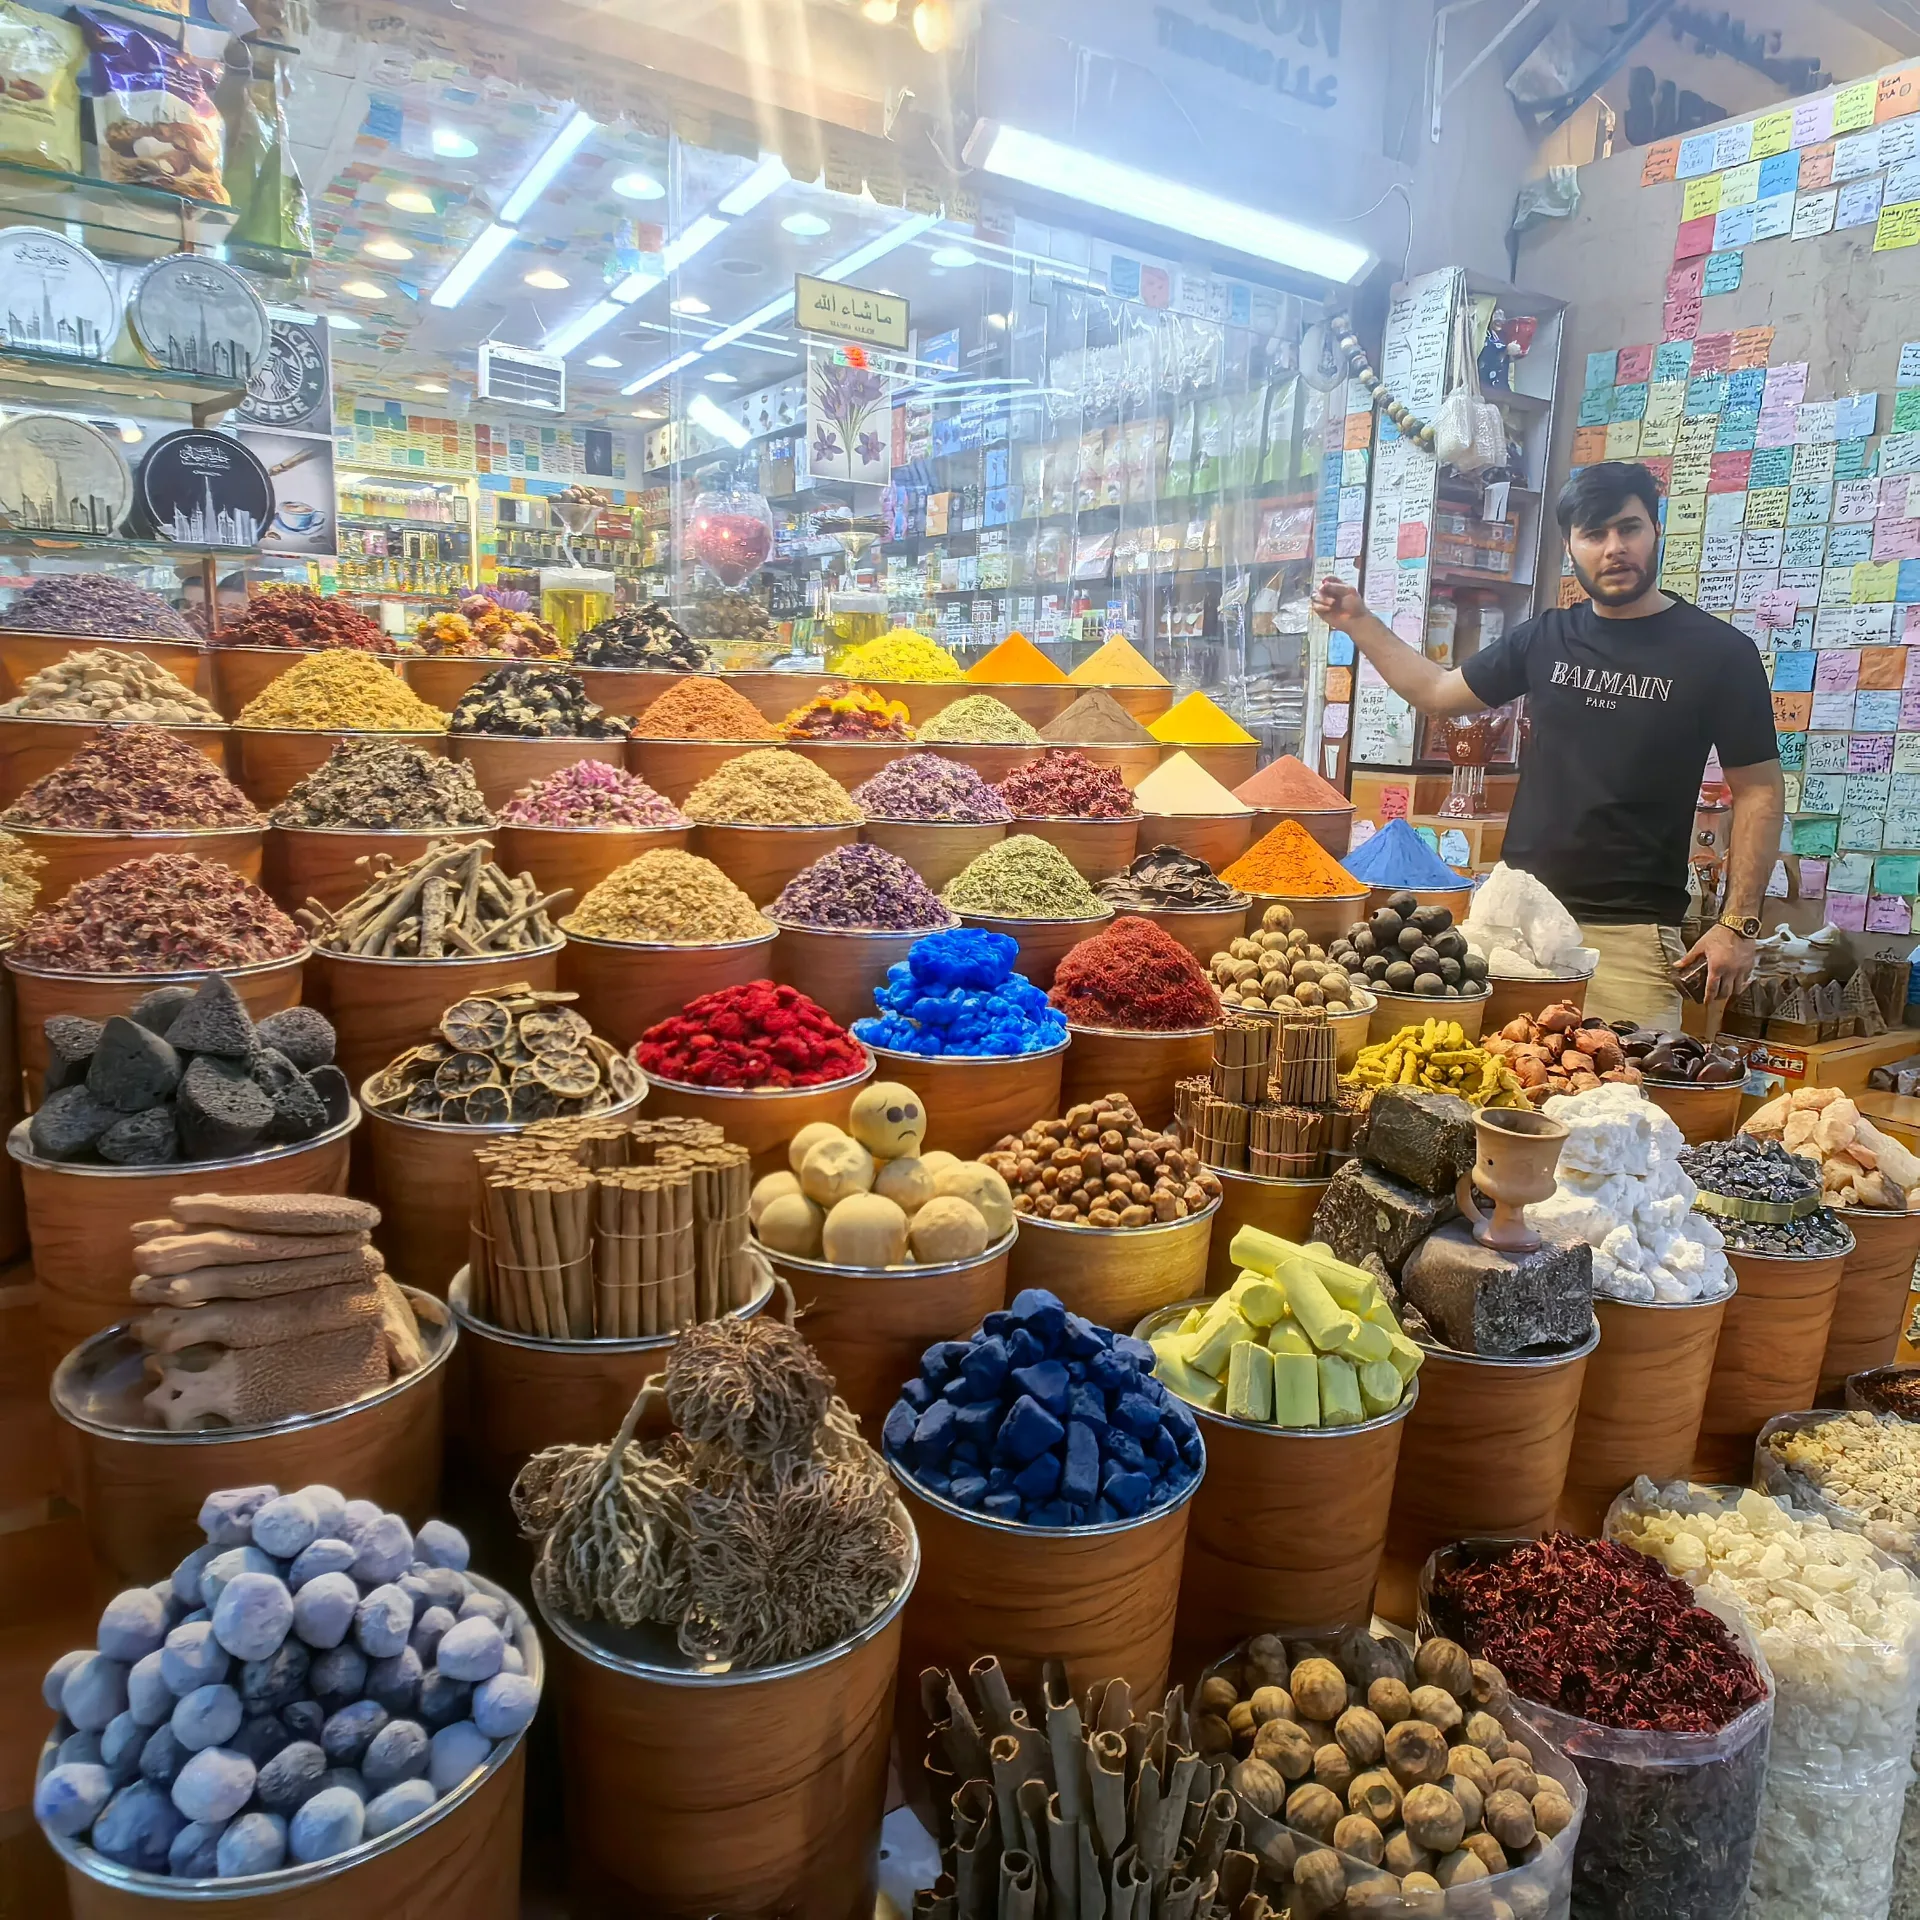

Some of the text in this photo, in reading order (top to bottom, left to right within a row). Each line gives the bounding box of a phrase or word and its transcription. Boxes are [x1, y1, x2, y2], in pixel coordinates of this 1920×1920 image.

[814, 293, 836, 313] الله
[239, 395, 310, 420] OFFEE
[1550, 661, 1674, 702] BALMAIN
[1585, 696, 1617, 710] PARIS
